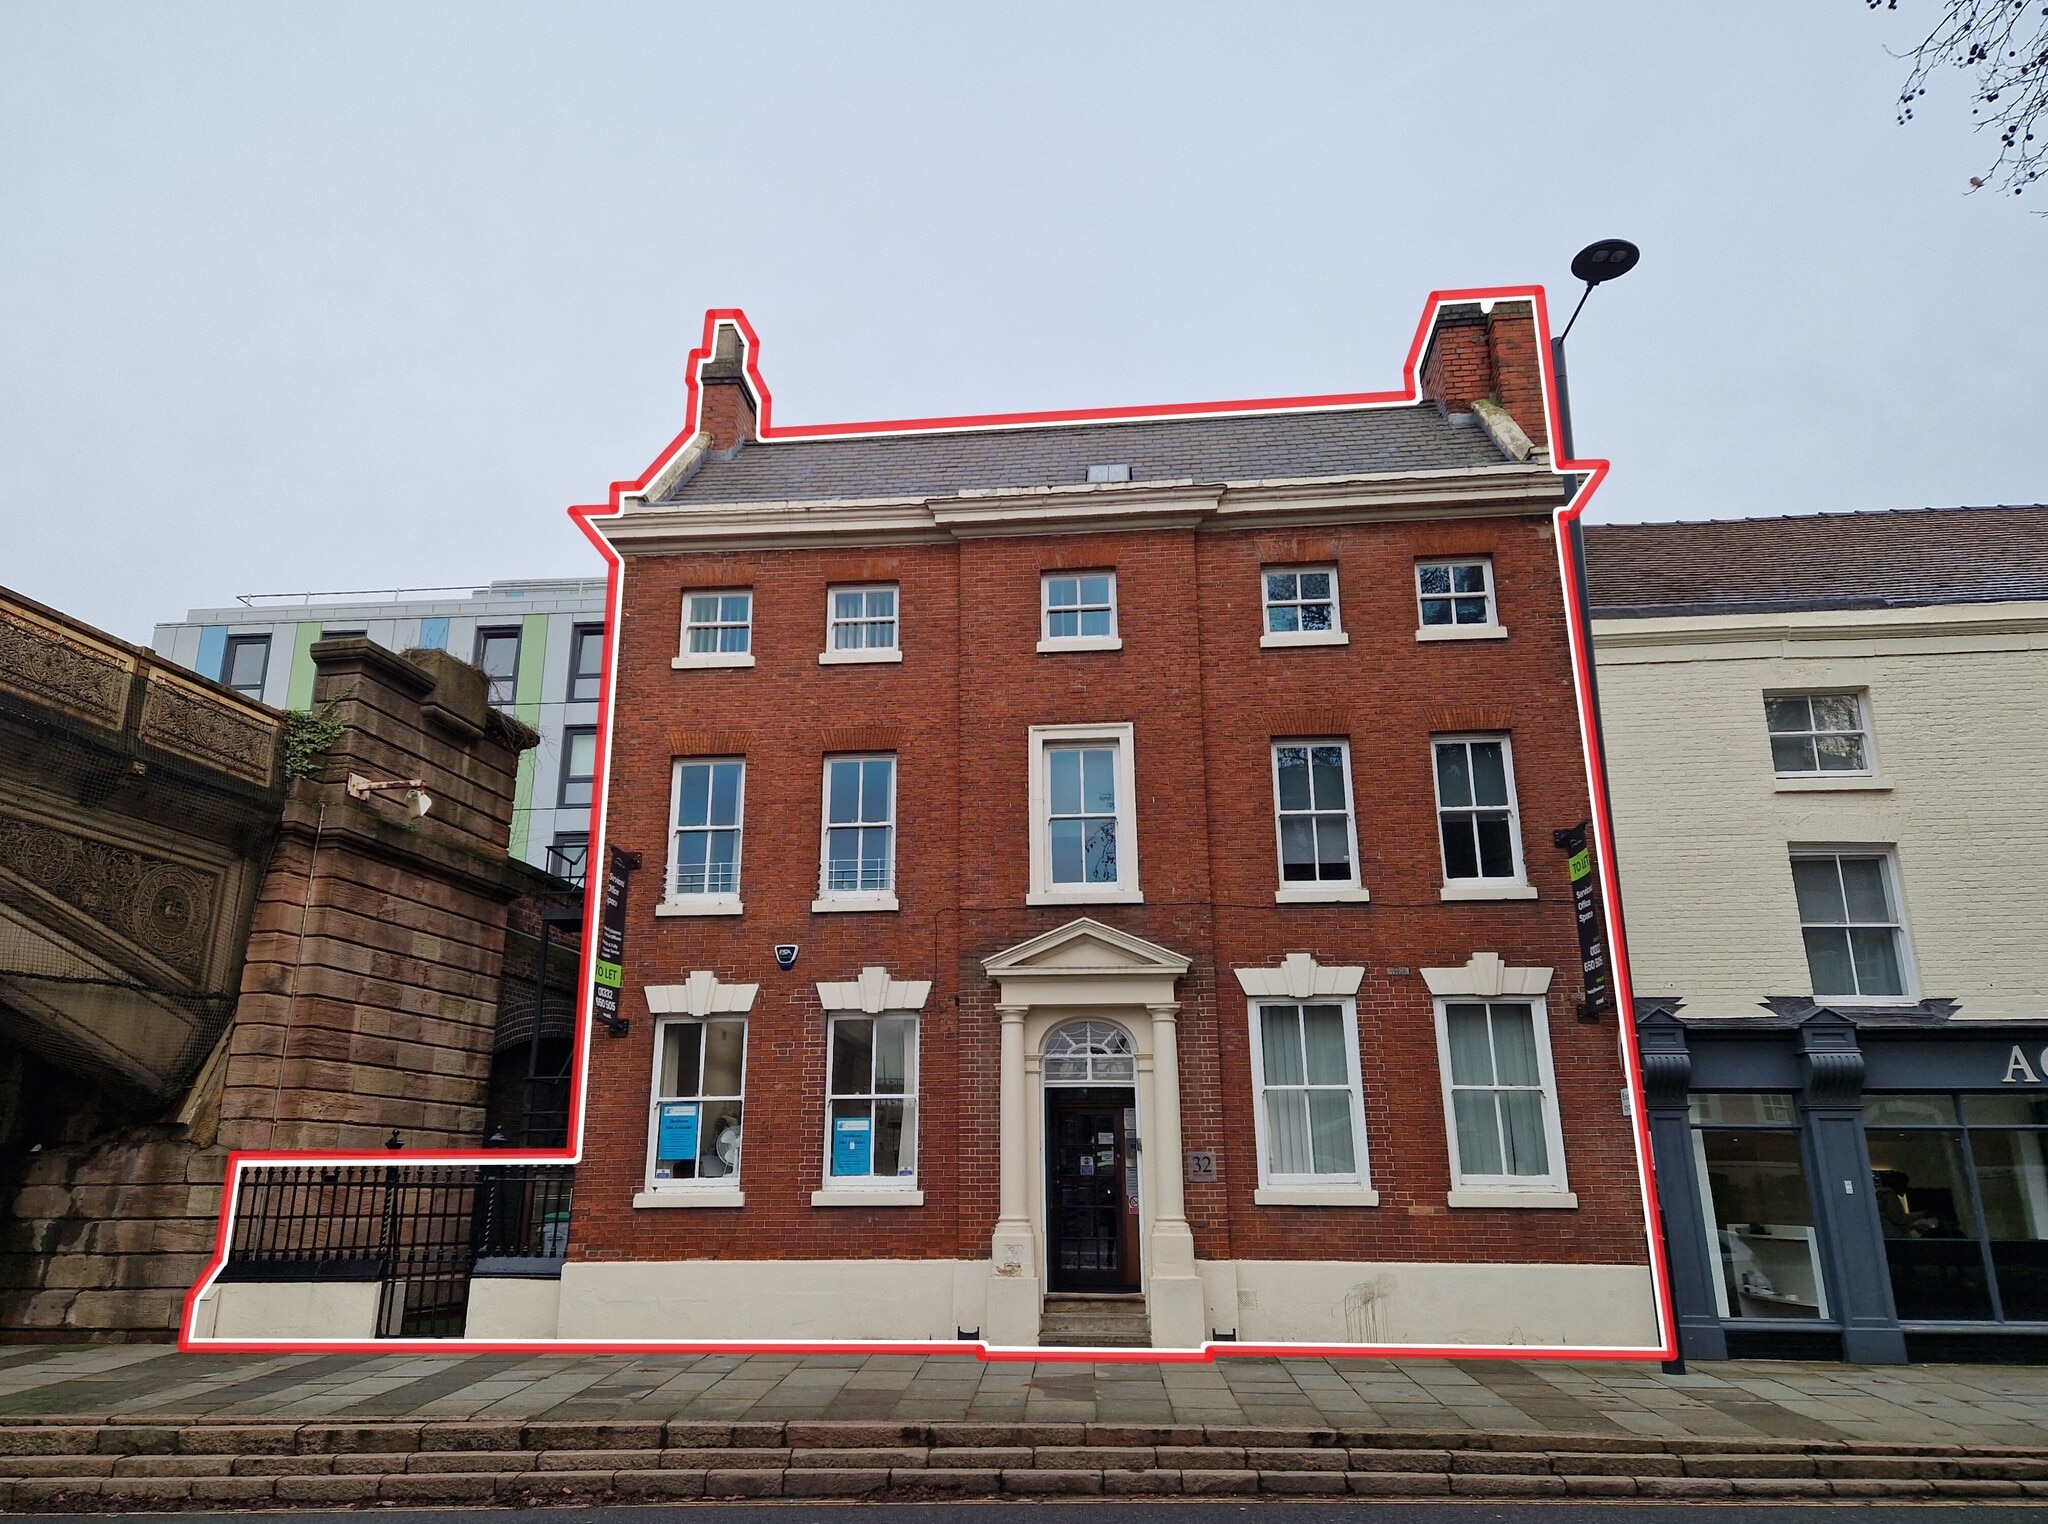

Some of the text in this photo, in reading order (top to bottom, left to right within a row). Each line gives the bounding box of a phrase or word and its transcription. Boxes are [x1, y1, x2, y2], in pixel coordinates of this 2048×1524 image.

[1572, 862, 1581, 874] TO
[605, 967, 617, 980] LET
[1193, 1156, 1212, 1173] 32
